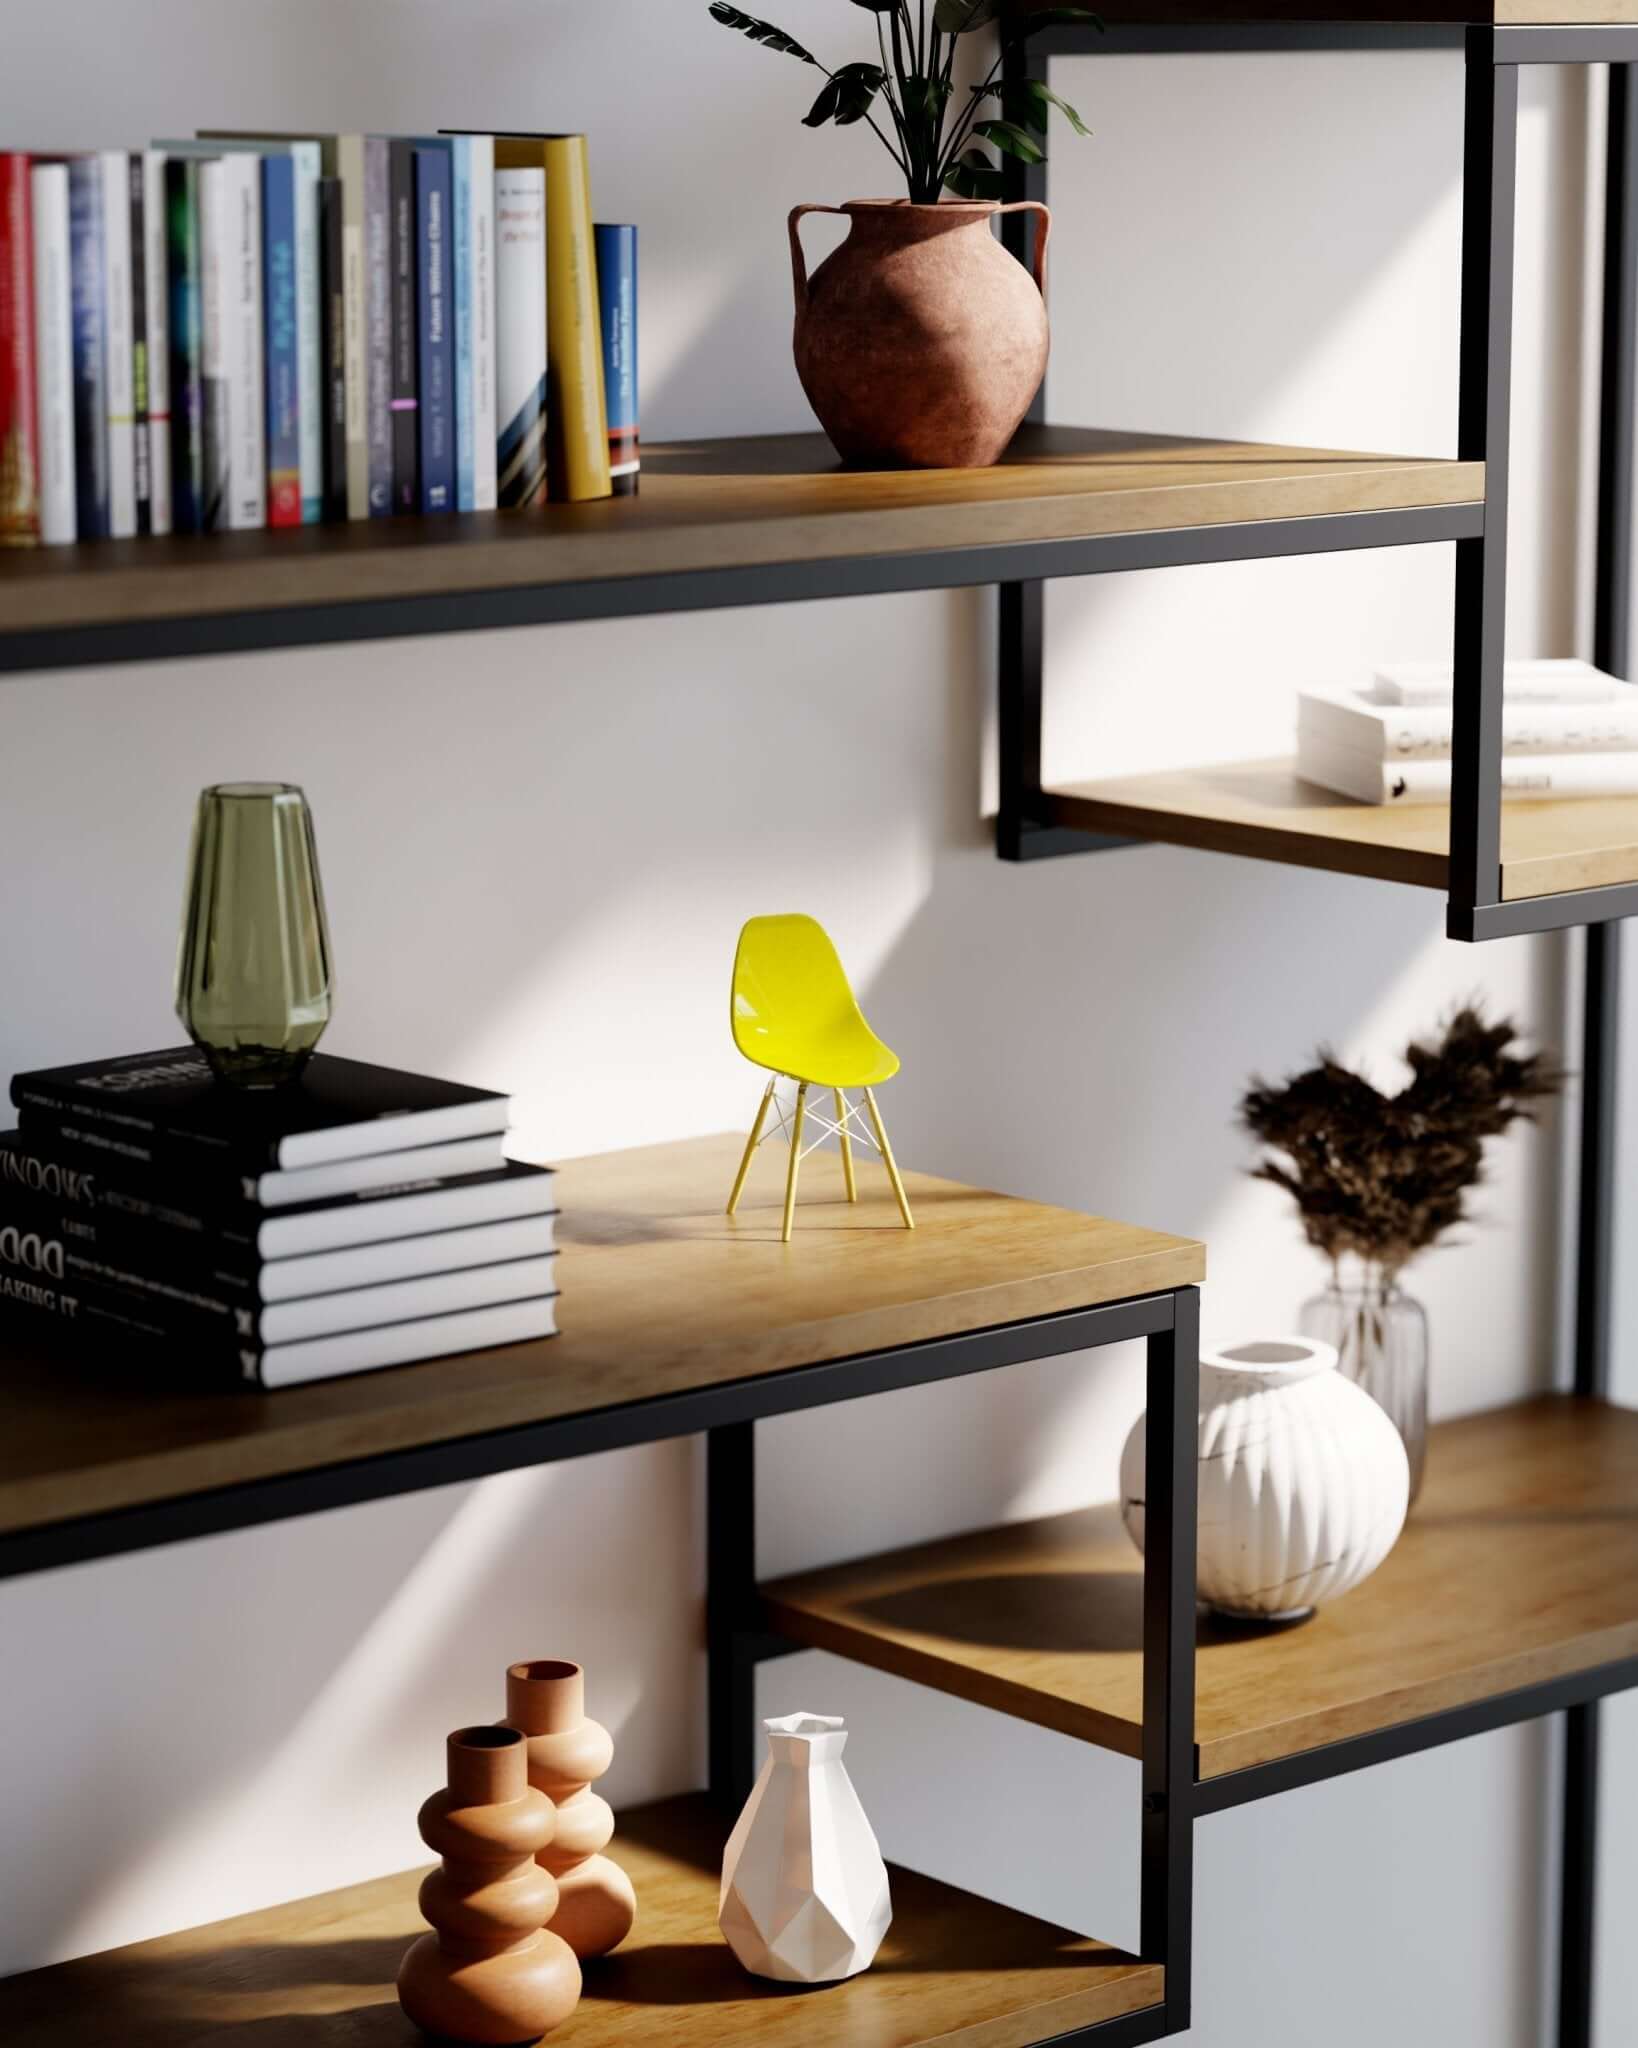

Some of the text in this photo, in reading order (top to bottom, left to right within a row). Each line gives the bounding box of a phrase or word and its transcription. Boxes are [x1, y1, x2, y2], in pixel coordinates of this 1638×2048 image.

[429, 241, 442, 296] Without
[430, 297, 442, 343] Future
[59, 1294, 80, 1319] IT
